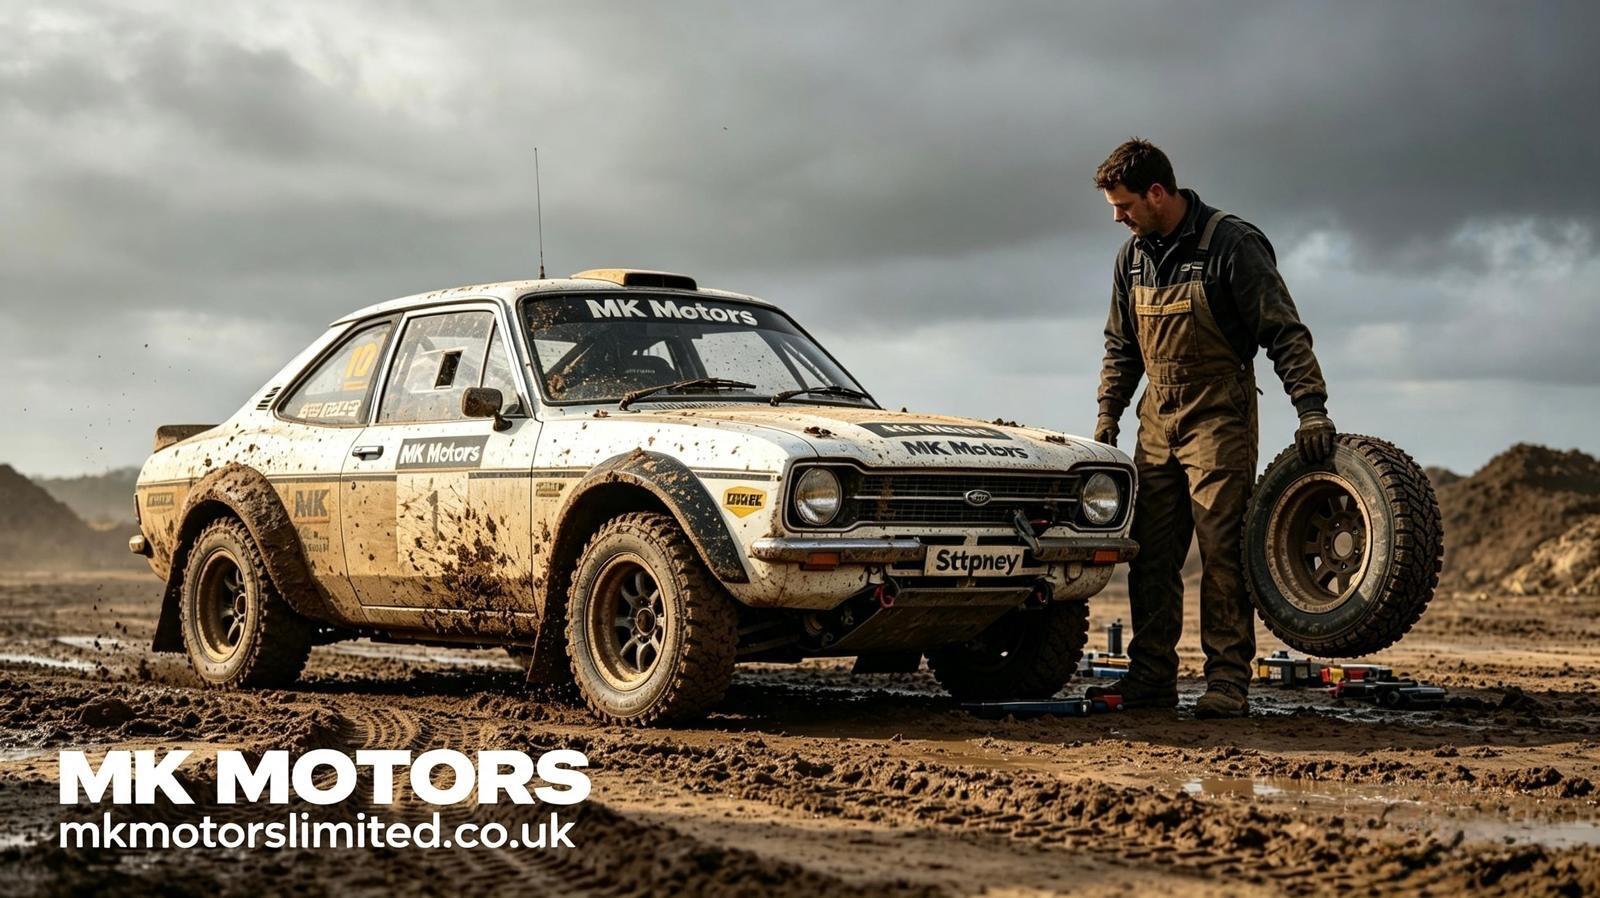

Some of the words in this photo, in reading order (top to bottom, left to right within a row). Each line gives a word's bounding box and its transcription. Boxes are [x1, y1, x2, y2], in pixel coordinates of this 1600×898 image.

[585, 299, 648, 319] MK
[648, 299, 758, 327] Motors
[400, 444, 426, 464] MK
[426, 442, 481, 463] Motors
[902, 440, 952, 456] MK
[947, 440, 1029, 460] Motors
[295, 489, 330, 518] MK
[935, 549, 1020, 577] Sttpney
